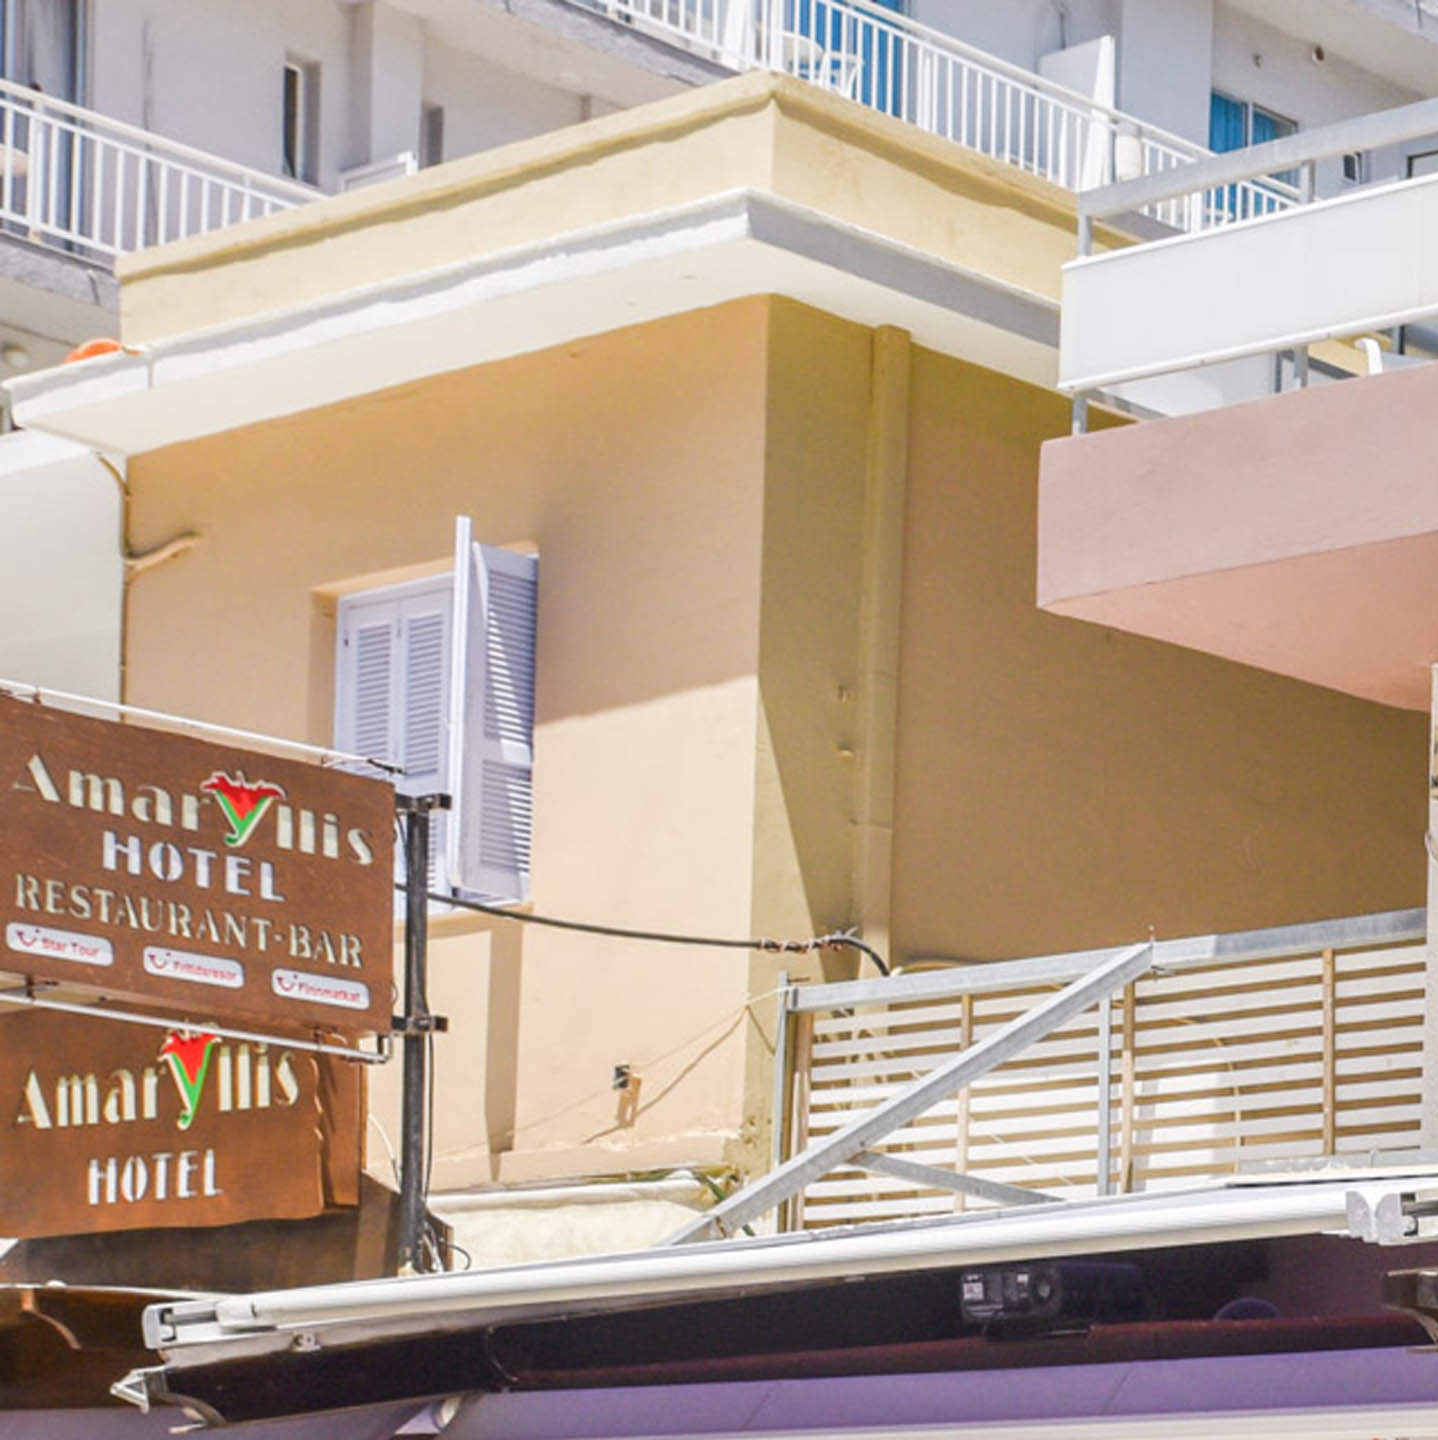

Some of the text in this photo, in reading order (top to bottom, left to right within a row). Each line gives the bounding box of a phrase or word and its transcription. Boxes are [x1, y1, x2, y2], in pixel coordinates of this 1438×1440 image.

[12, 753, 374, 865] Amaryllis
[103, 831, 286, 903] HOTEL
[16, 1024, 300, 1131] Amaryllis
[88, 1147, 223, 1206] HOTEL
